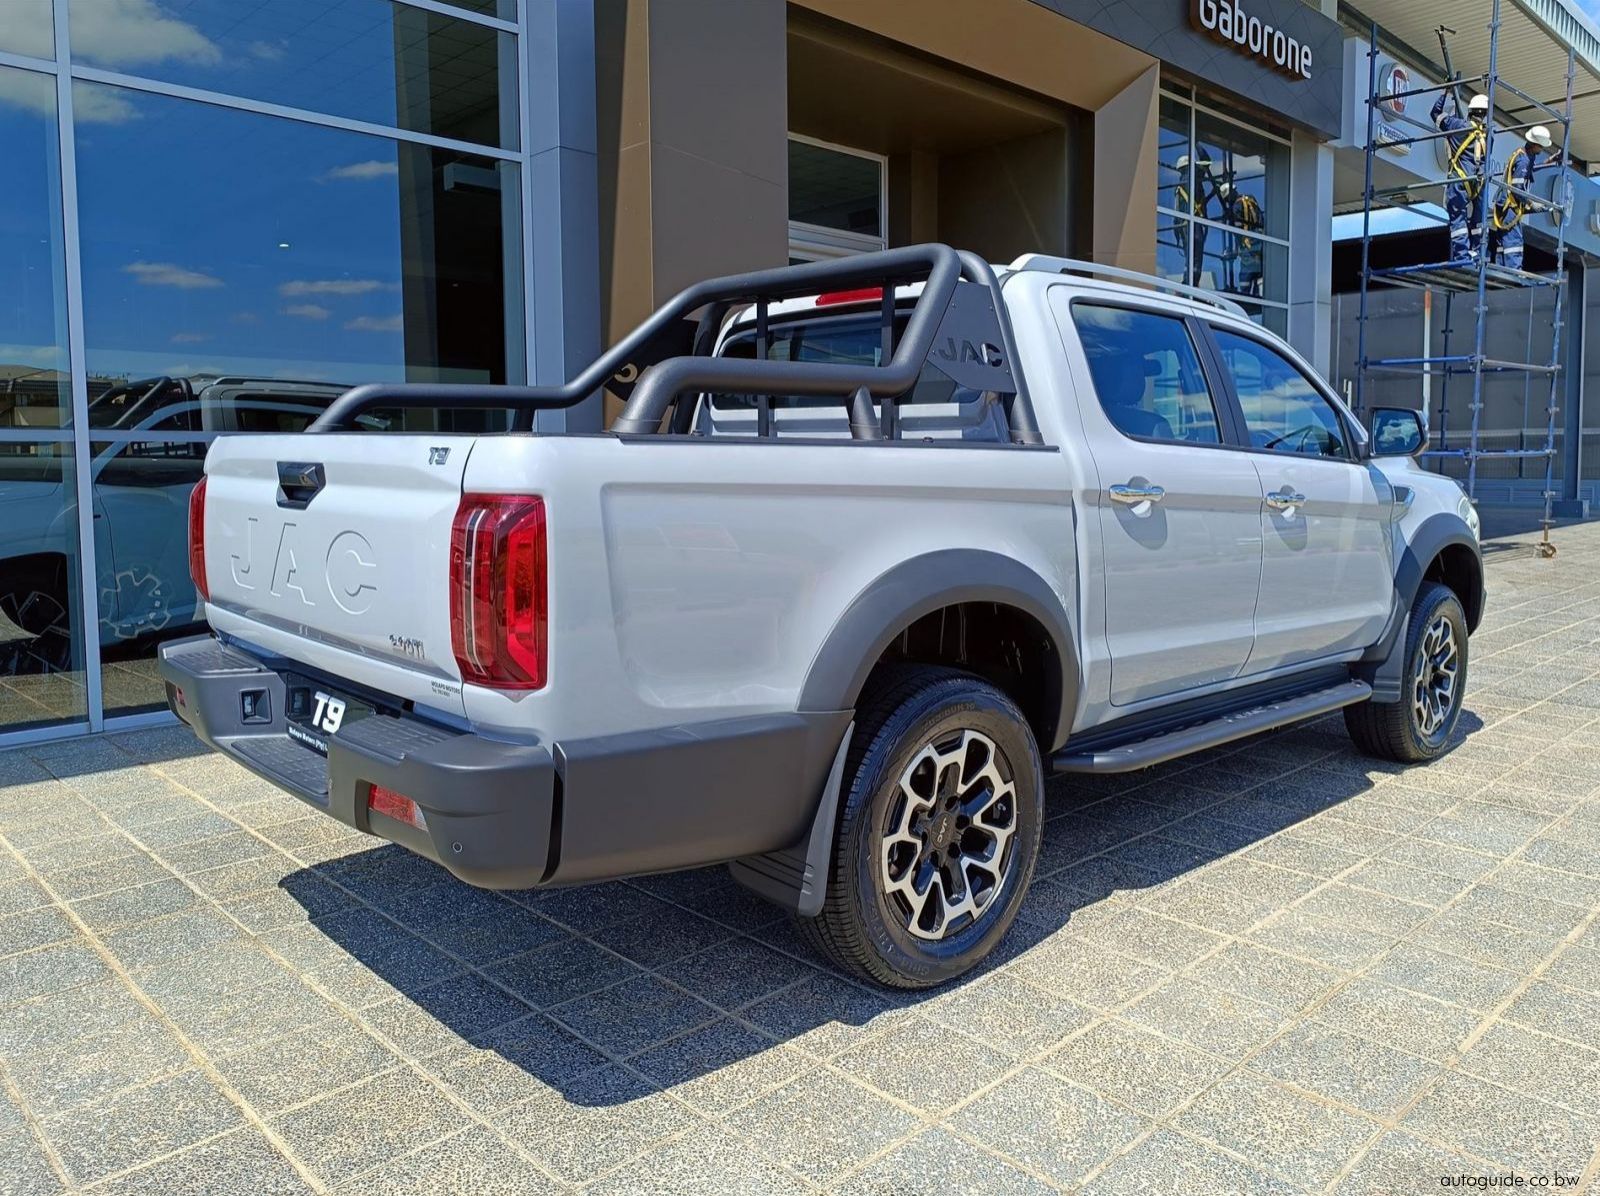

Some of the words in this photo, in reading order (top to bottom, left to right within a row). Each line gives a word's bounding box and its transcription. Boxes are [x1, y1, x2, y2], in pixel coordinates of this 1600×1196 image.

[1200, 0, 1313, 79] Gaborone
[938, 337, 1003, 367] JAC
[429, 446, 451, 465] T9
[231, 517, 377, 615] JAC
[312, 691, 346, 734] T9
